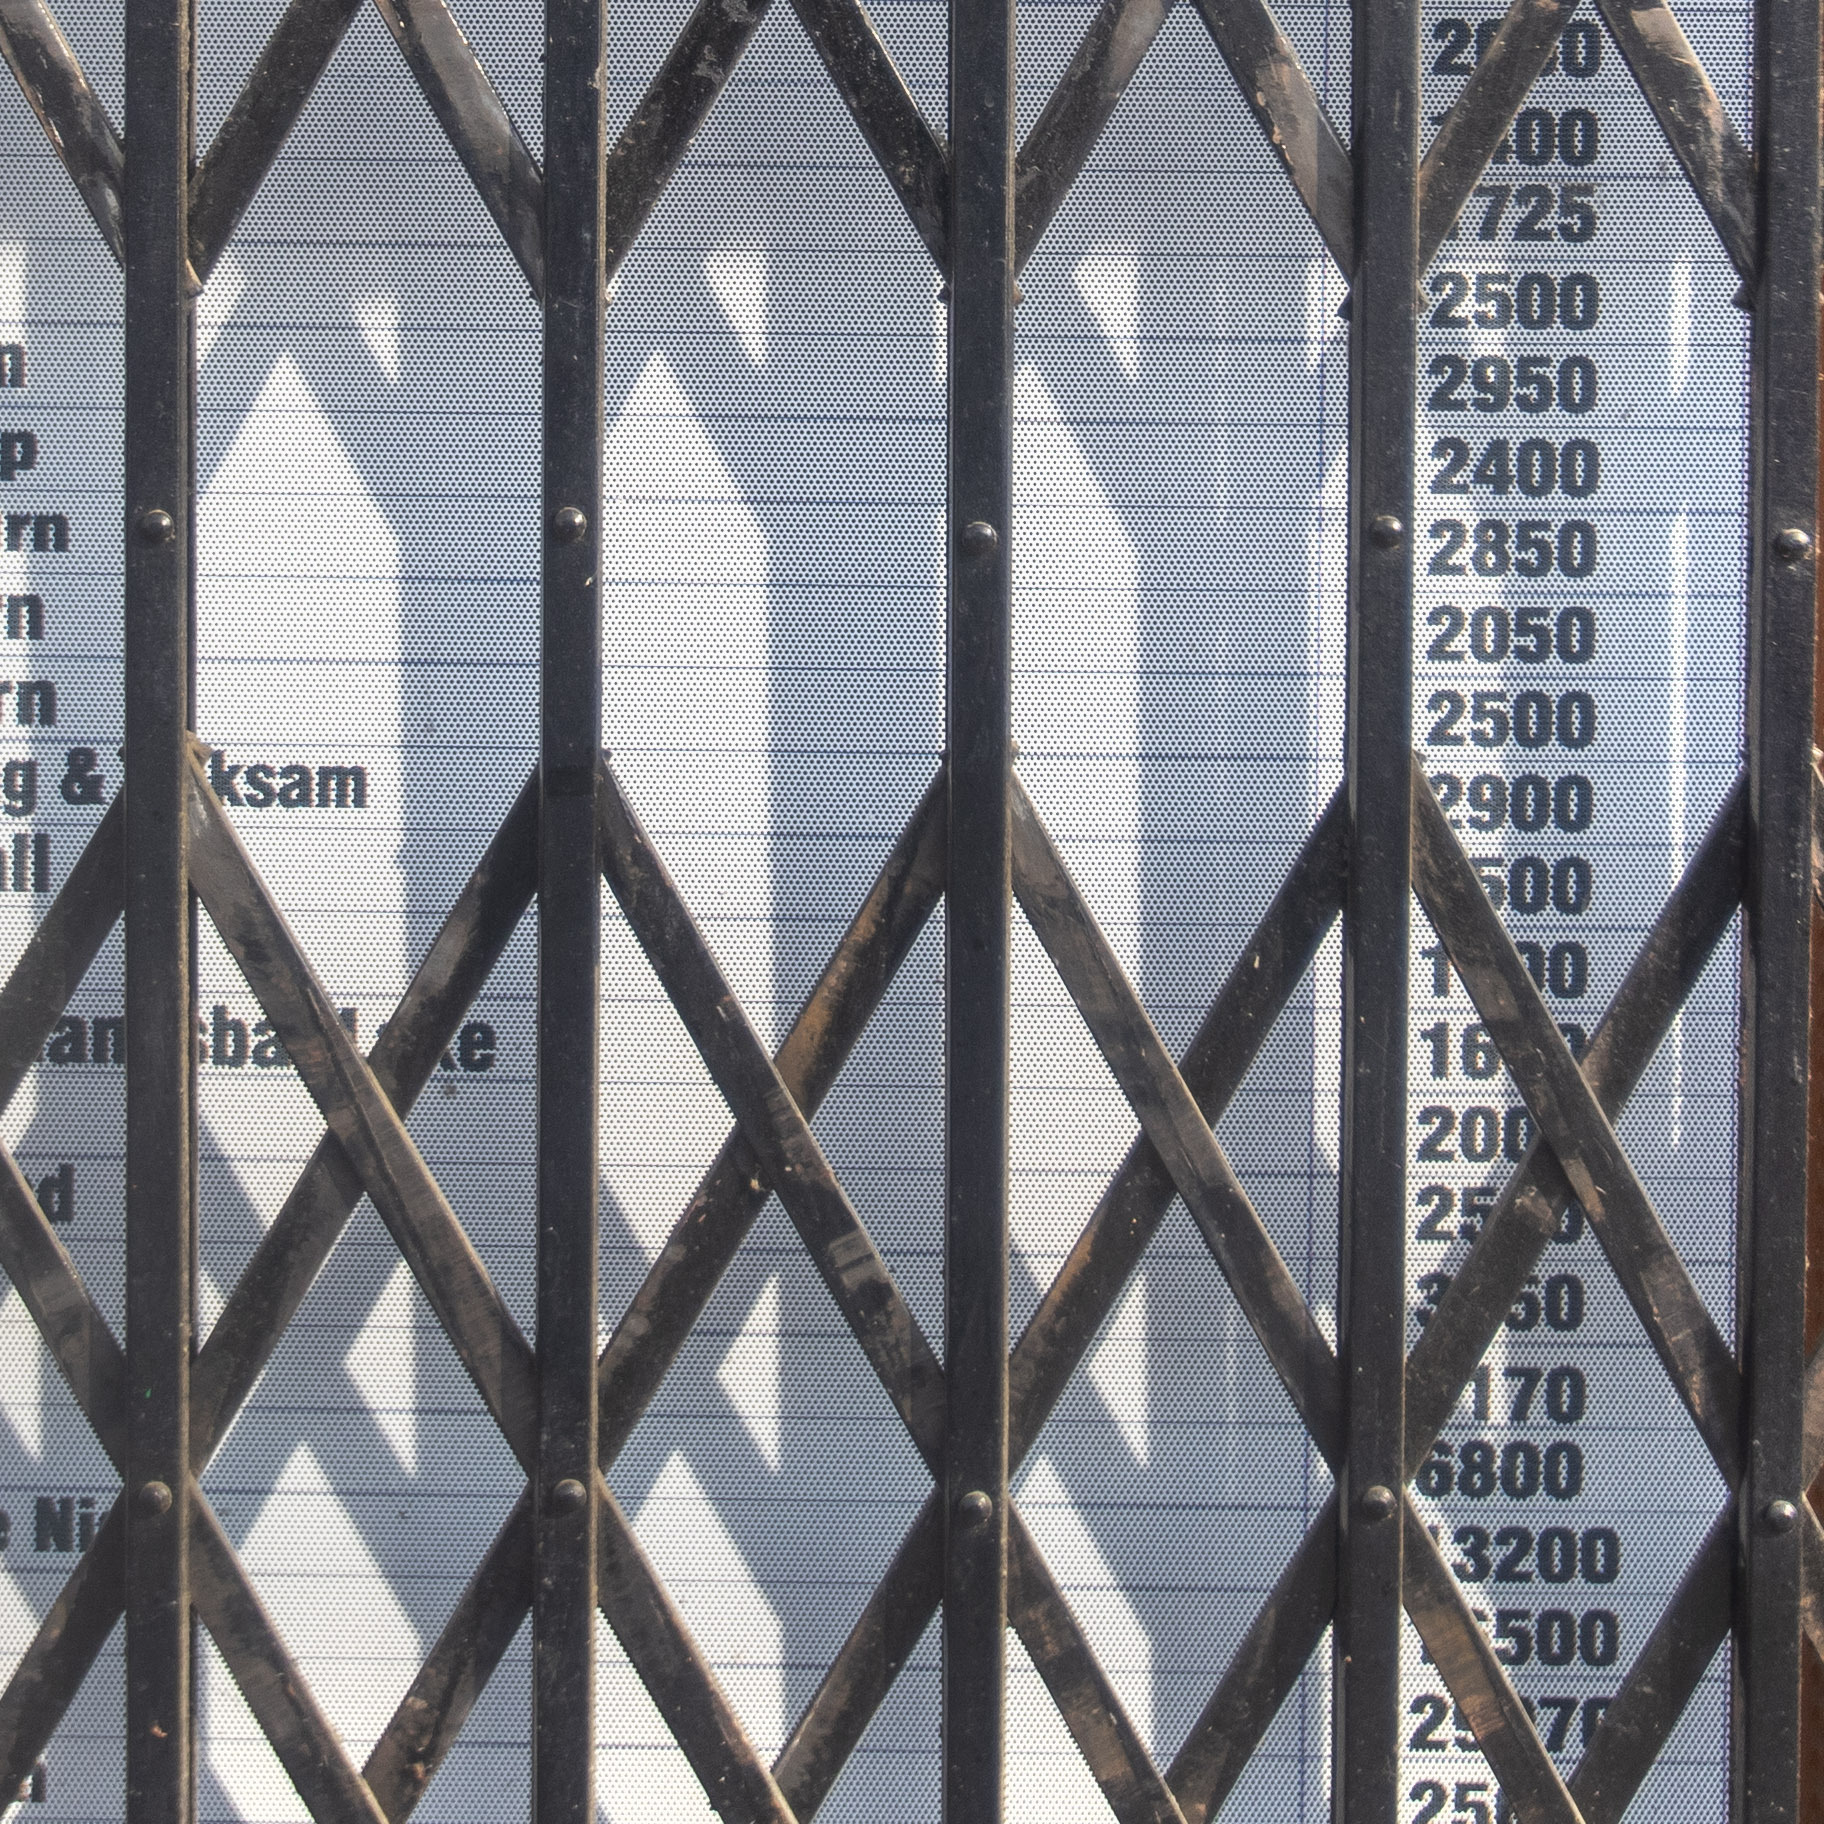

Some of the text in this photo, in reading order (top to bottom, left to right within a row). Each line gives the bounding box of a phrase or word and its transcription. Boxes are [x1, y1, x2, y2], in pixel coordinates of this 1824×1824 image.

[1450, 184, 1599, 243] 725
[1428, 272, 1602, 332] 2500
[1427, 354, 1600, 414] 2950
[1428, 437, 1602, 499] 2400
[1426, 518, 1600, 579] 2850
[1426, 605, 1600, 665] 2050
[1426, 689, 1599, 749] 2500
[59, 747, 107, 806] &
[1428, 773, 1596, 833] 2900
[1470, 856, 1594, 916] 500
[1415, 1439, 1584, 1500] 6800
